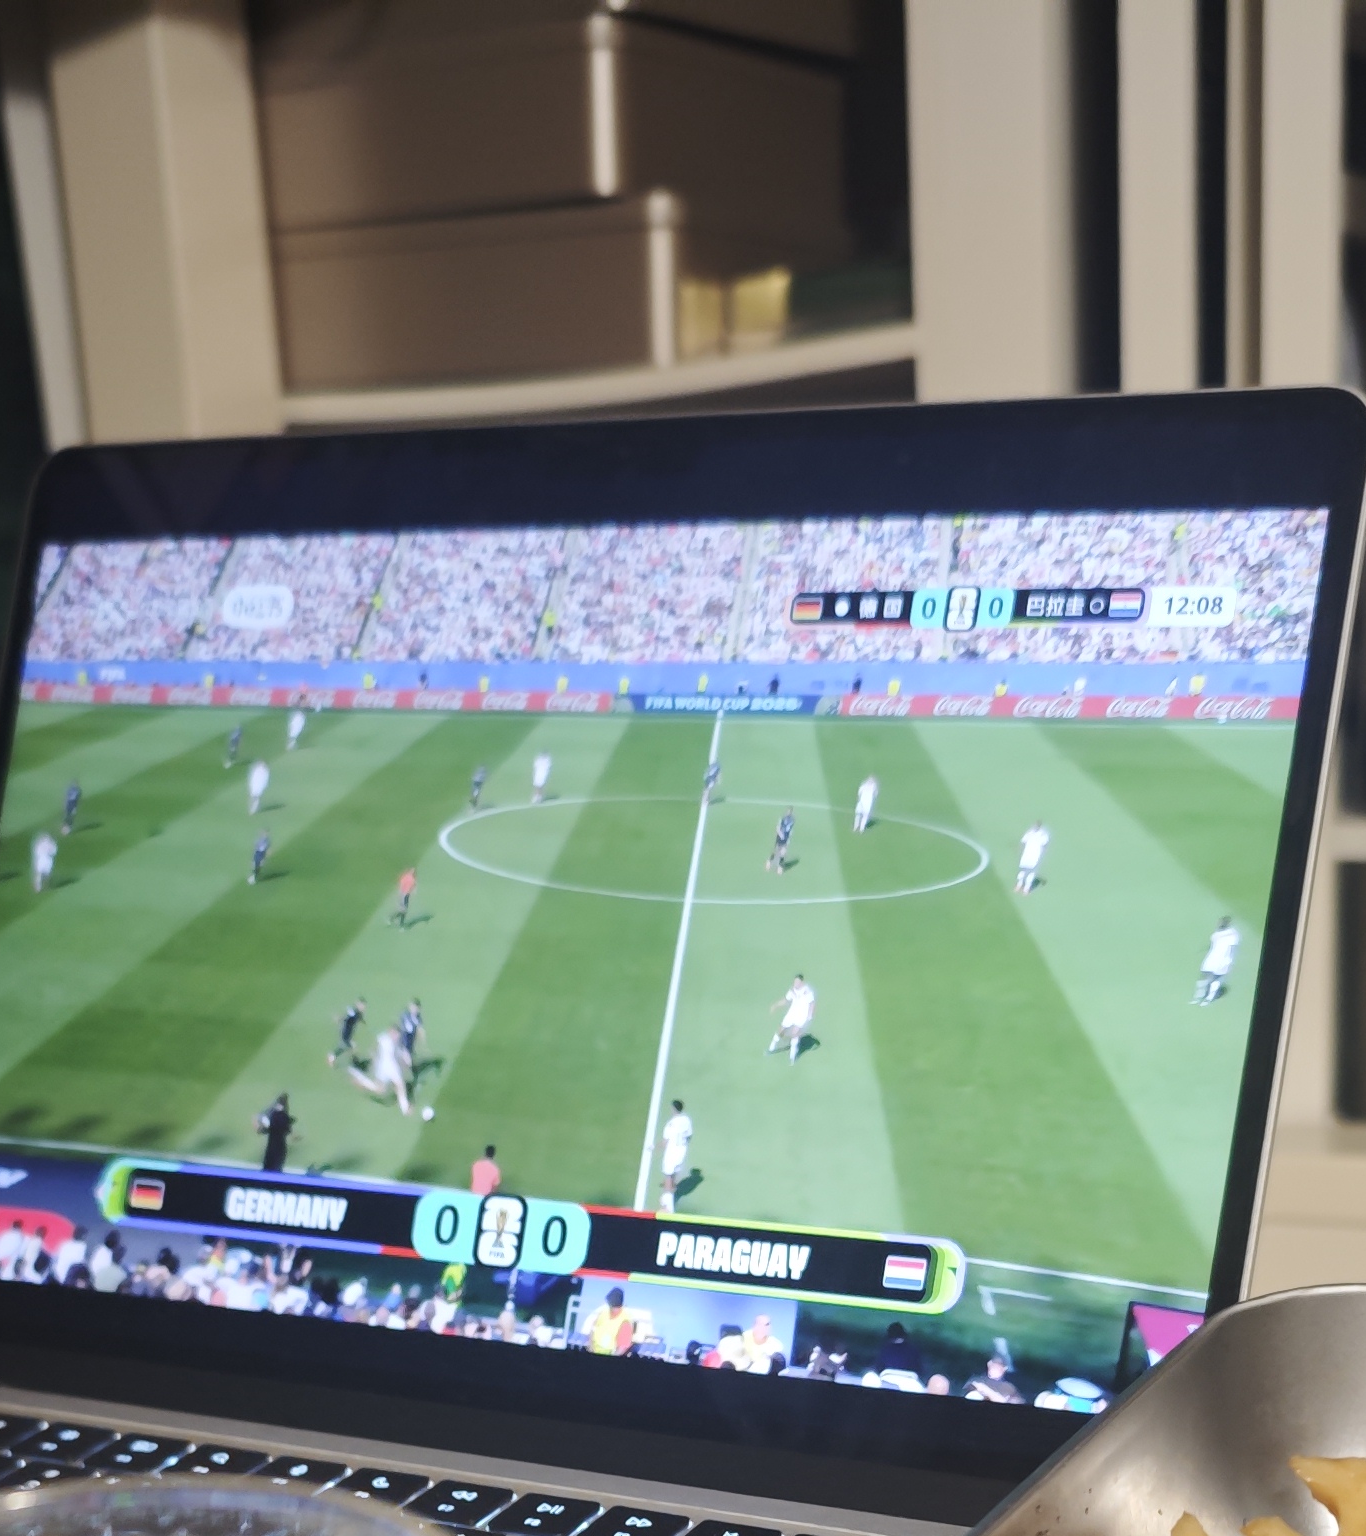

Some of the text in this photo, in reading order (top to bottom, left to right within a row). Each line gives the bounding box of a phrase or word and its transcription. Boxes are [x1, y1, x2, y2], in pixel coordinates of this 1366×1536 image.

[921, 597, 937, 619] 0
[987, 596, 1004, 618] 0
[1163, 595, 1224, 616] 12:08
[644, 696, 673, 711] FIFA
[674, 696, 721, 711] WORLD
[722, 697, 750, 711] CUP
[224, 1186, 811, 1281] GERMANY 0 0 PARAGUAY
